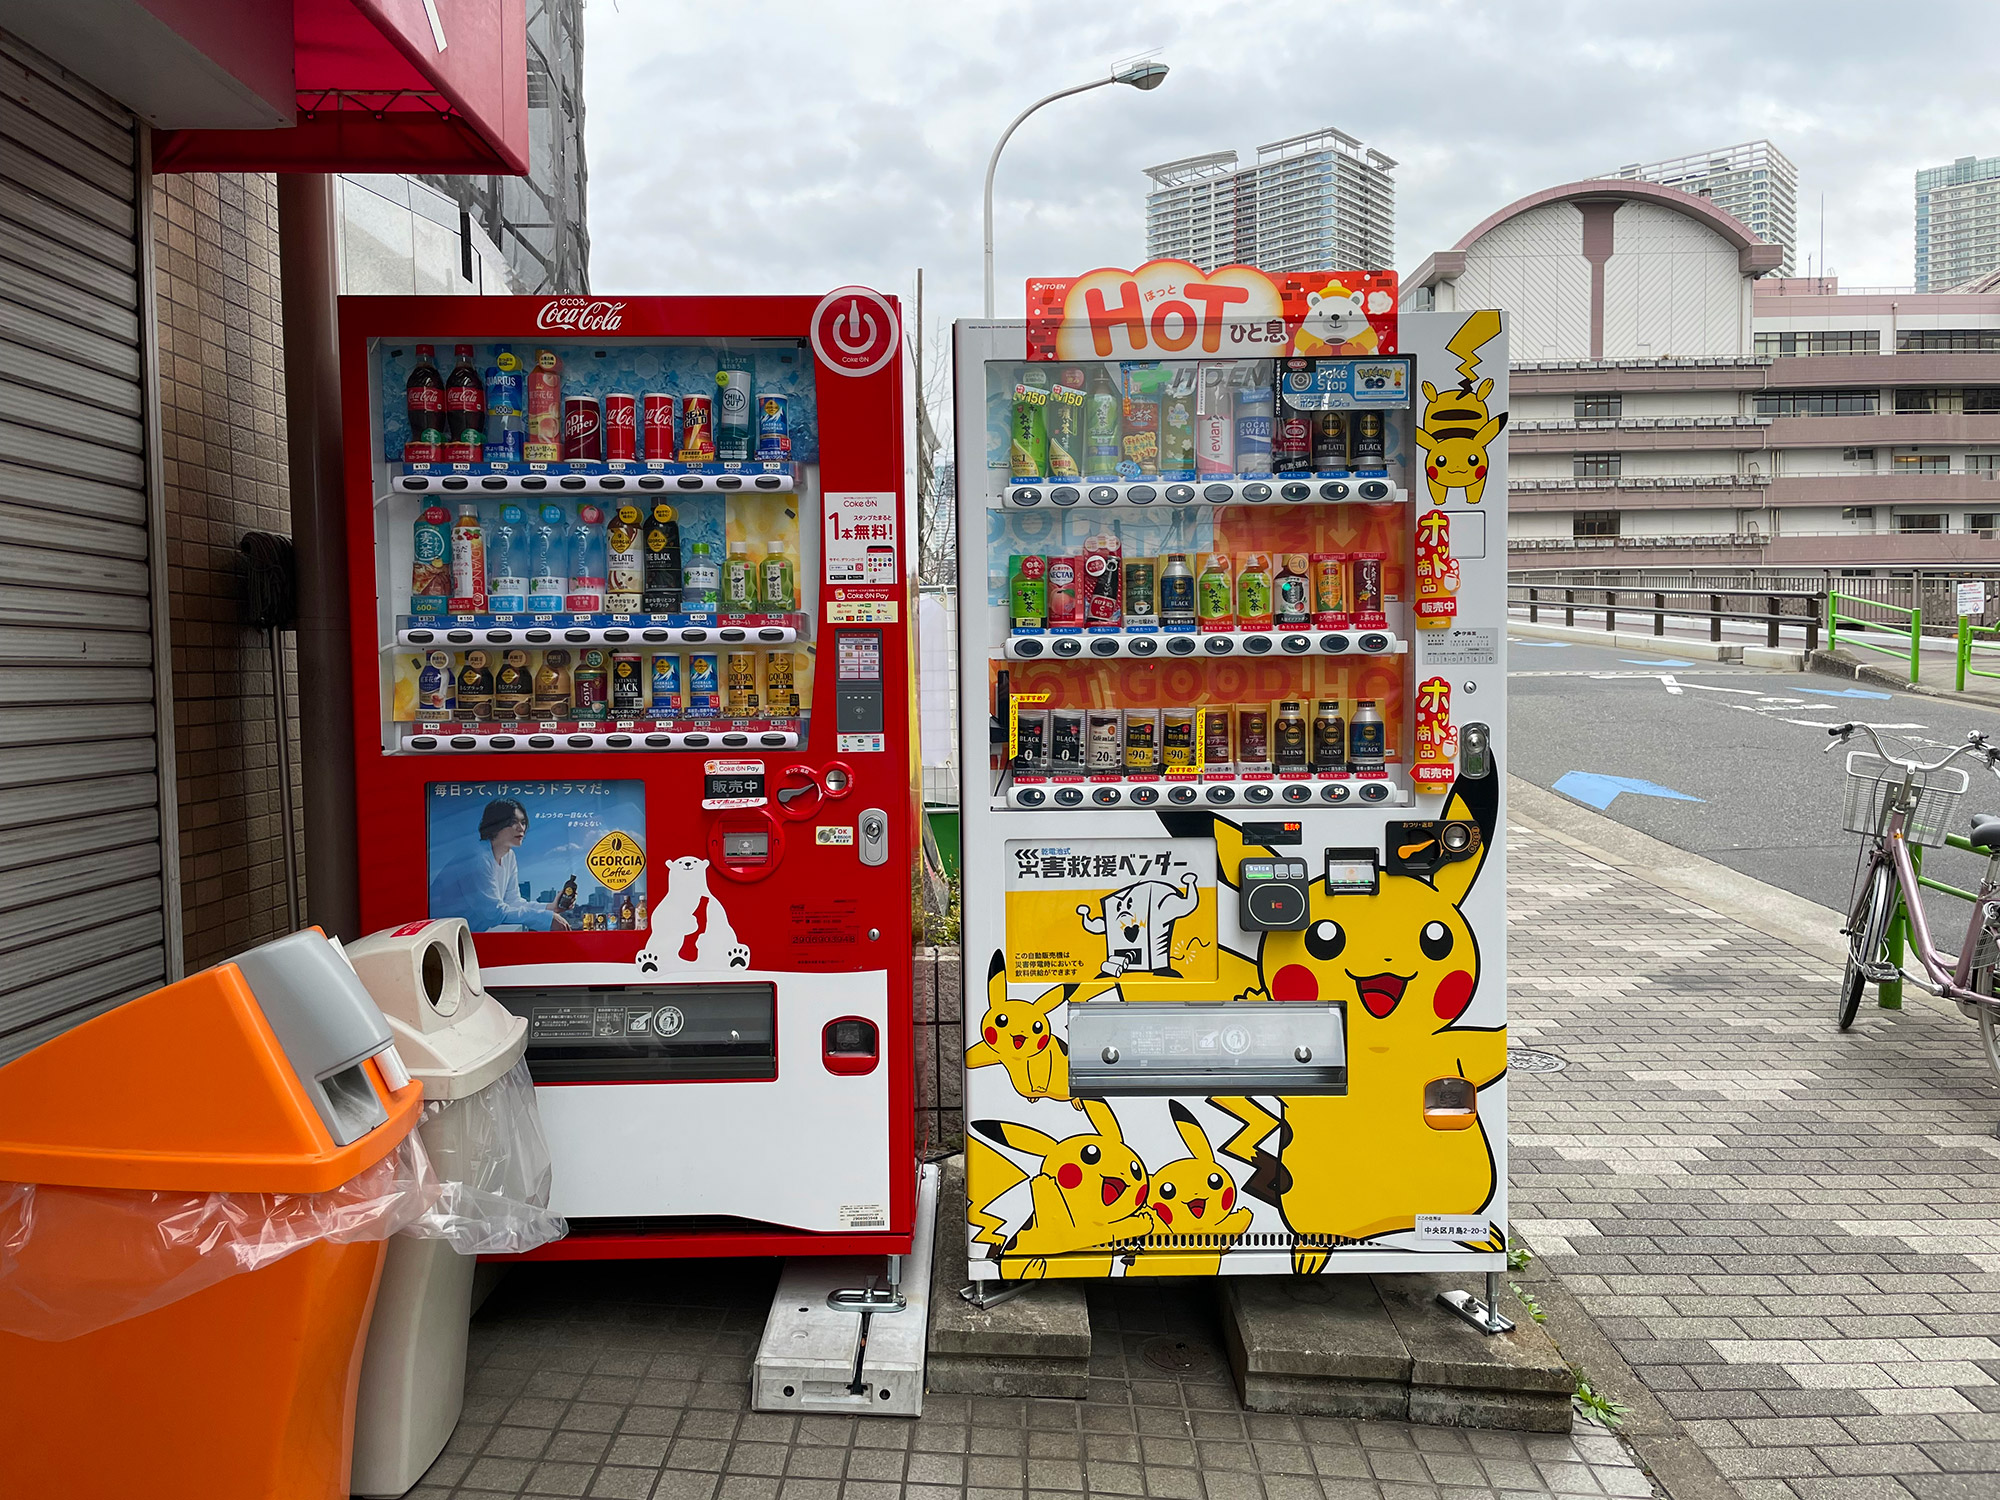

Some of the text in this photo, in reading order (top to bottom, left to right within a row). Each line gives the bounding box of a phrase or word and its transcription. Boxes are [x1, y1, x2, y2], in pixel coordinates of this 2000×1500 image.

[1143, 285, 1177, 302] ほっと
[536, 301, 627, 331] Coca-Cola
[1230, 320, 1287, 343] ひと息
[1317, 366, 1348, 379] Poké
[1317, 379, 1347, 391] Stop
[1365, 378, 1386, 389] GO
[724, 393, 743, 401] CHILL
[1021, 392, 1046, 405] ¥150
[1059, 392, 1083, 406] ¥150
[571, 414, 585, 425] Dr
[685, 408, 706, 420] REAL
[565, 419, 593, 437] Pepper
[685, 416, 707, 429] GOLD
[1211, 422, 1220, 451] evian
[828, 512, 893, 540] 1本無料!
[420, 532, 434, 558] 麦茶
[1419, 512, 1449, 578] ホット
[609, 554, 634, 562] THE LATTE
[654, 553, 671, 561] BLACK
[472, 544, 484, 593] ADVANCE
[1418, 559, 1437, 593] 商品
[1421, 601, 1455, 613] 販売中
[769, 673, 793, 681] GOLDEN
[615, 683, 638, 692] BLACK
[583, 682, 591, 706] COSTA
[1420, 680, 1449, 745] ホット
[1417, 724, 1436, 758] 商品
[1024, 750, 1033, 760] 0
[1061, 750, 1070, 760] 0
[1096, 752, 1109, 762] 20
[1132, 750, 1145, 760] 90
[1171, 750, 1183, 759] 90
[1419, 768, 1453, 779] 販売中
[434, 783, 611, 797] 毎日って、けっこうドラマだ。
[712, 780, 758, 794] 販売中
[590, 856, 643, 867] GEORGIA
[1015, 849, 1188, 879] 災害救援ベンダー
[602, 867, 633, 878] Coffee
[1015, 960, 1085, 968] 災害停電時においても
[1015, 969, 1077, 977] 飲料供給ができます
[1424, 1227, 1487, 1235] 中央区月島2-20-3
